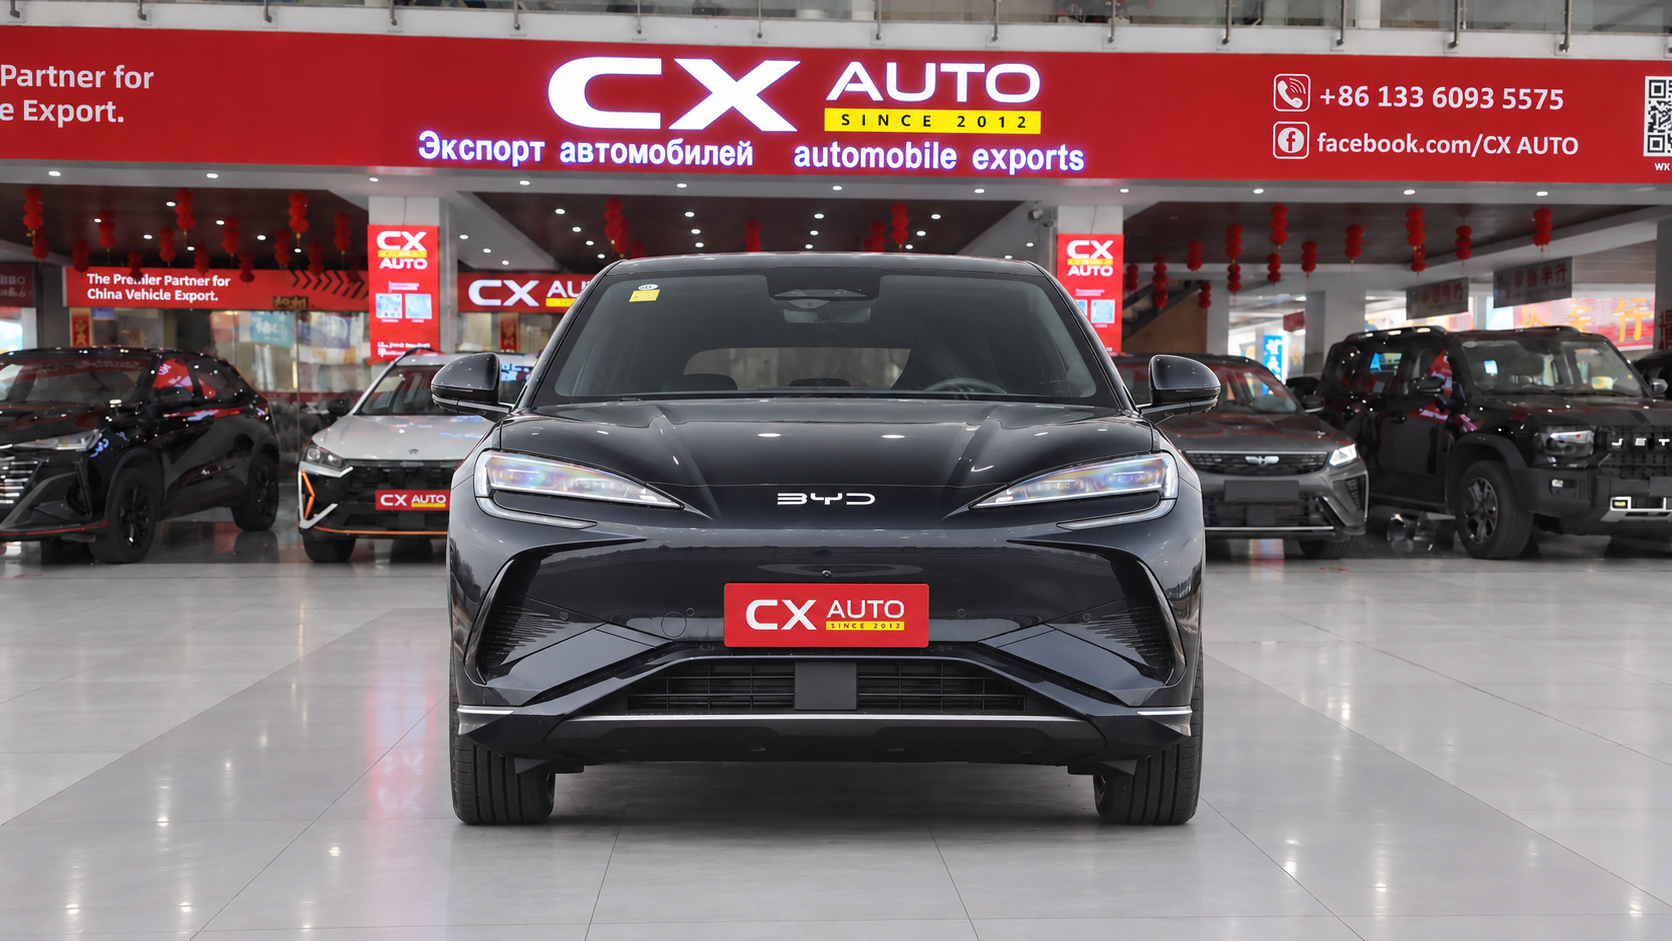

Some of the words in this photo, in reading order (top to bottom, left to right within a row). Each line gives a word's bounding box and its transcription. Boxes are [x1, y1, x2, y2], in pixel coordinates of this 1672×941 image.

[1, 64, 106, 88] Partner
[114, 64, 155, 89] for
[547, 56, 801, 132] CX
[825, 61, 1041, 103] AUTO
[1319, 85, 1370, 108] +86
[1378, 86, 1424, 108] 133
[1432, 87, 1495, 109] 6093
[1502, 88, 1564, 111] 5575
[24, 99, 124, 128] Export.
[841, 113, 932, 128] SINCE
[956, 115, 1027, 129] 2012
[418, 130, 545, 168] Экспорт
[560, 137, 753, 166] автомобилей
[1317, 132, 1511, 158] facebook.com/CX
[1516, 136, 1579, 156] AUTO
[793, 141, 958, 170] automobile
[972, 143, 1085, 175] exports
[376, 230, 427, 251] CX
[1066, 239, 1114, 260] CX
[379, 257, 428, 270] AUTO
[1067, 264, 1114, 277] AUTO
[87, 273, 111, 285] The
[164, 275, 211, 287] Partner
[212, 275, 231, 287] for
[87, 288, 123, 300] China
[125, 288, 172, 301] Vehicle
[175, 290, 219, 303] Export.
[467, 279, 541, 307] CX
[547, 280, 590, 298] AU
[380, 493, 408, 507] CX
[411, 494, 447, 504] AUTO
[776, 492, 876, 506] BYD
[745, 599, 818, 631] CX
[826, 600, 905, 619] AUTO
